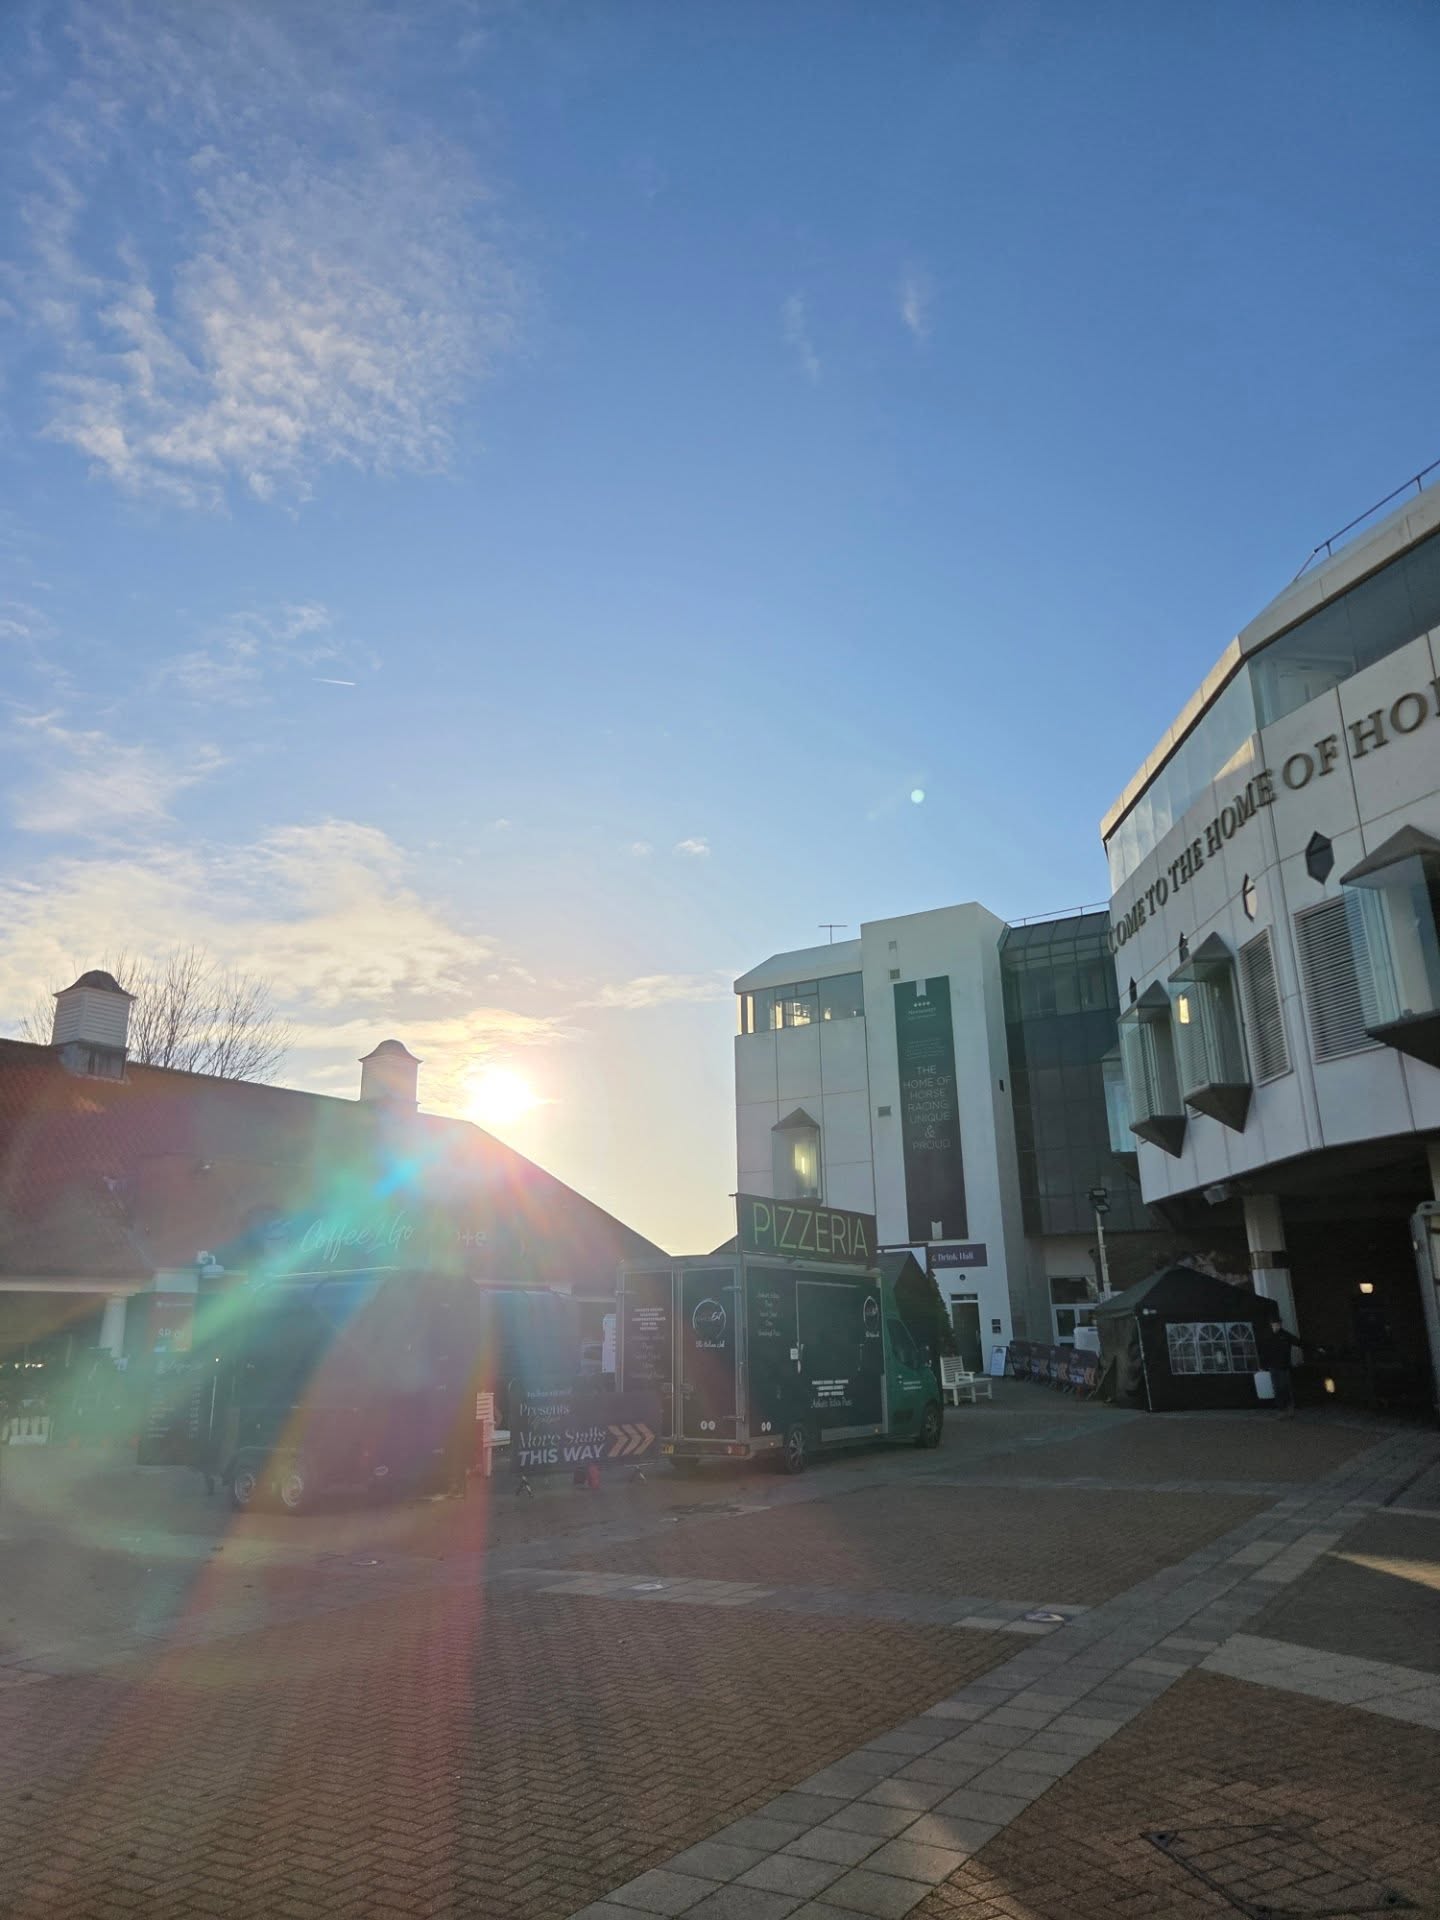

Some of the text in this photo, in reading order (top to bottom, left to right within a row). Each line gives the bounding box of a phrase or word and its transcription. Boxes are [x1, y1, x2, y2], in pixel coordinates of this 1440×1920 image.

[1107, 897, 1147, 954] COME
[1145, 876, 1169, 917] TO
[1167, 831, 1205, 894] THE
[1202, 769, 1278, 859] HOME
[1282, 734, 1339, 790] OF
[916, 1065, 937, 1075] THE
[903, 1075, 953, 1089] HOME OF
[910, 1088, 946, 1101] HORSE
[907, 1100, 949, 1113] RACING
[909, 1111, 952, 1124] UNIQUE
[924, 1125, 937, 1139] &
[912, 1139, 952, 1152] PROUD
[752, 1201, 869, 1257] PIZZERIA
[300, 1219, 369, 1264] Coffee
[937, 1252, 958, 1262] Drink
[959, 1250, 974, 1261] Hall
[519, 1402, 570, 1417] Presents
[519, 1426, 607, 1449] More Stalls
[519, 1444, 606, 1467] THIS WAY
